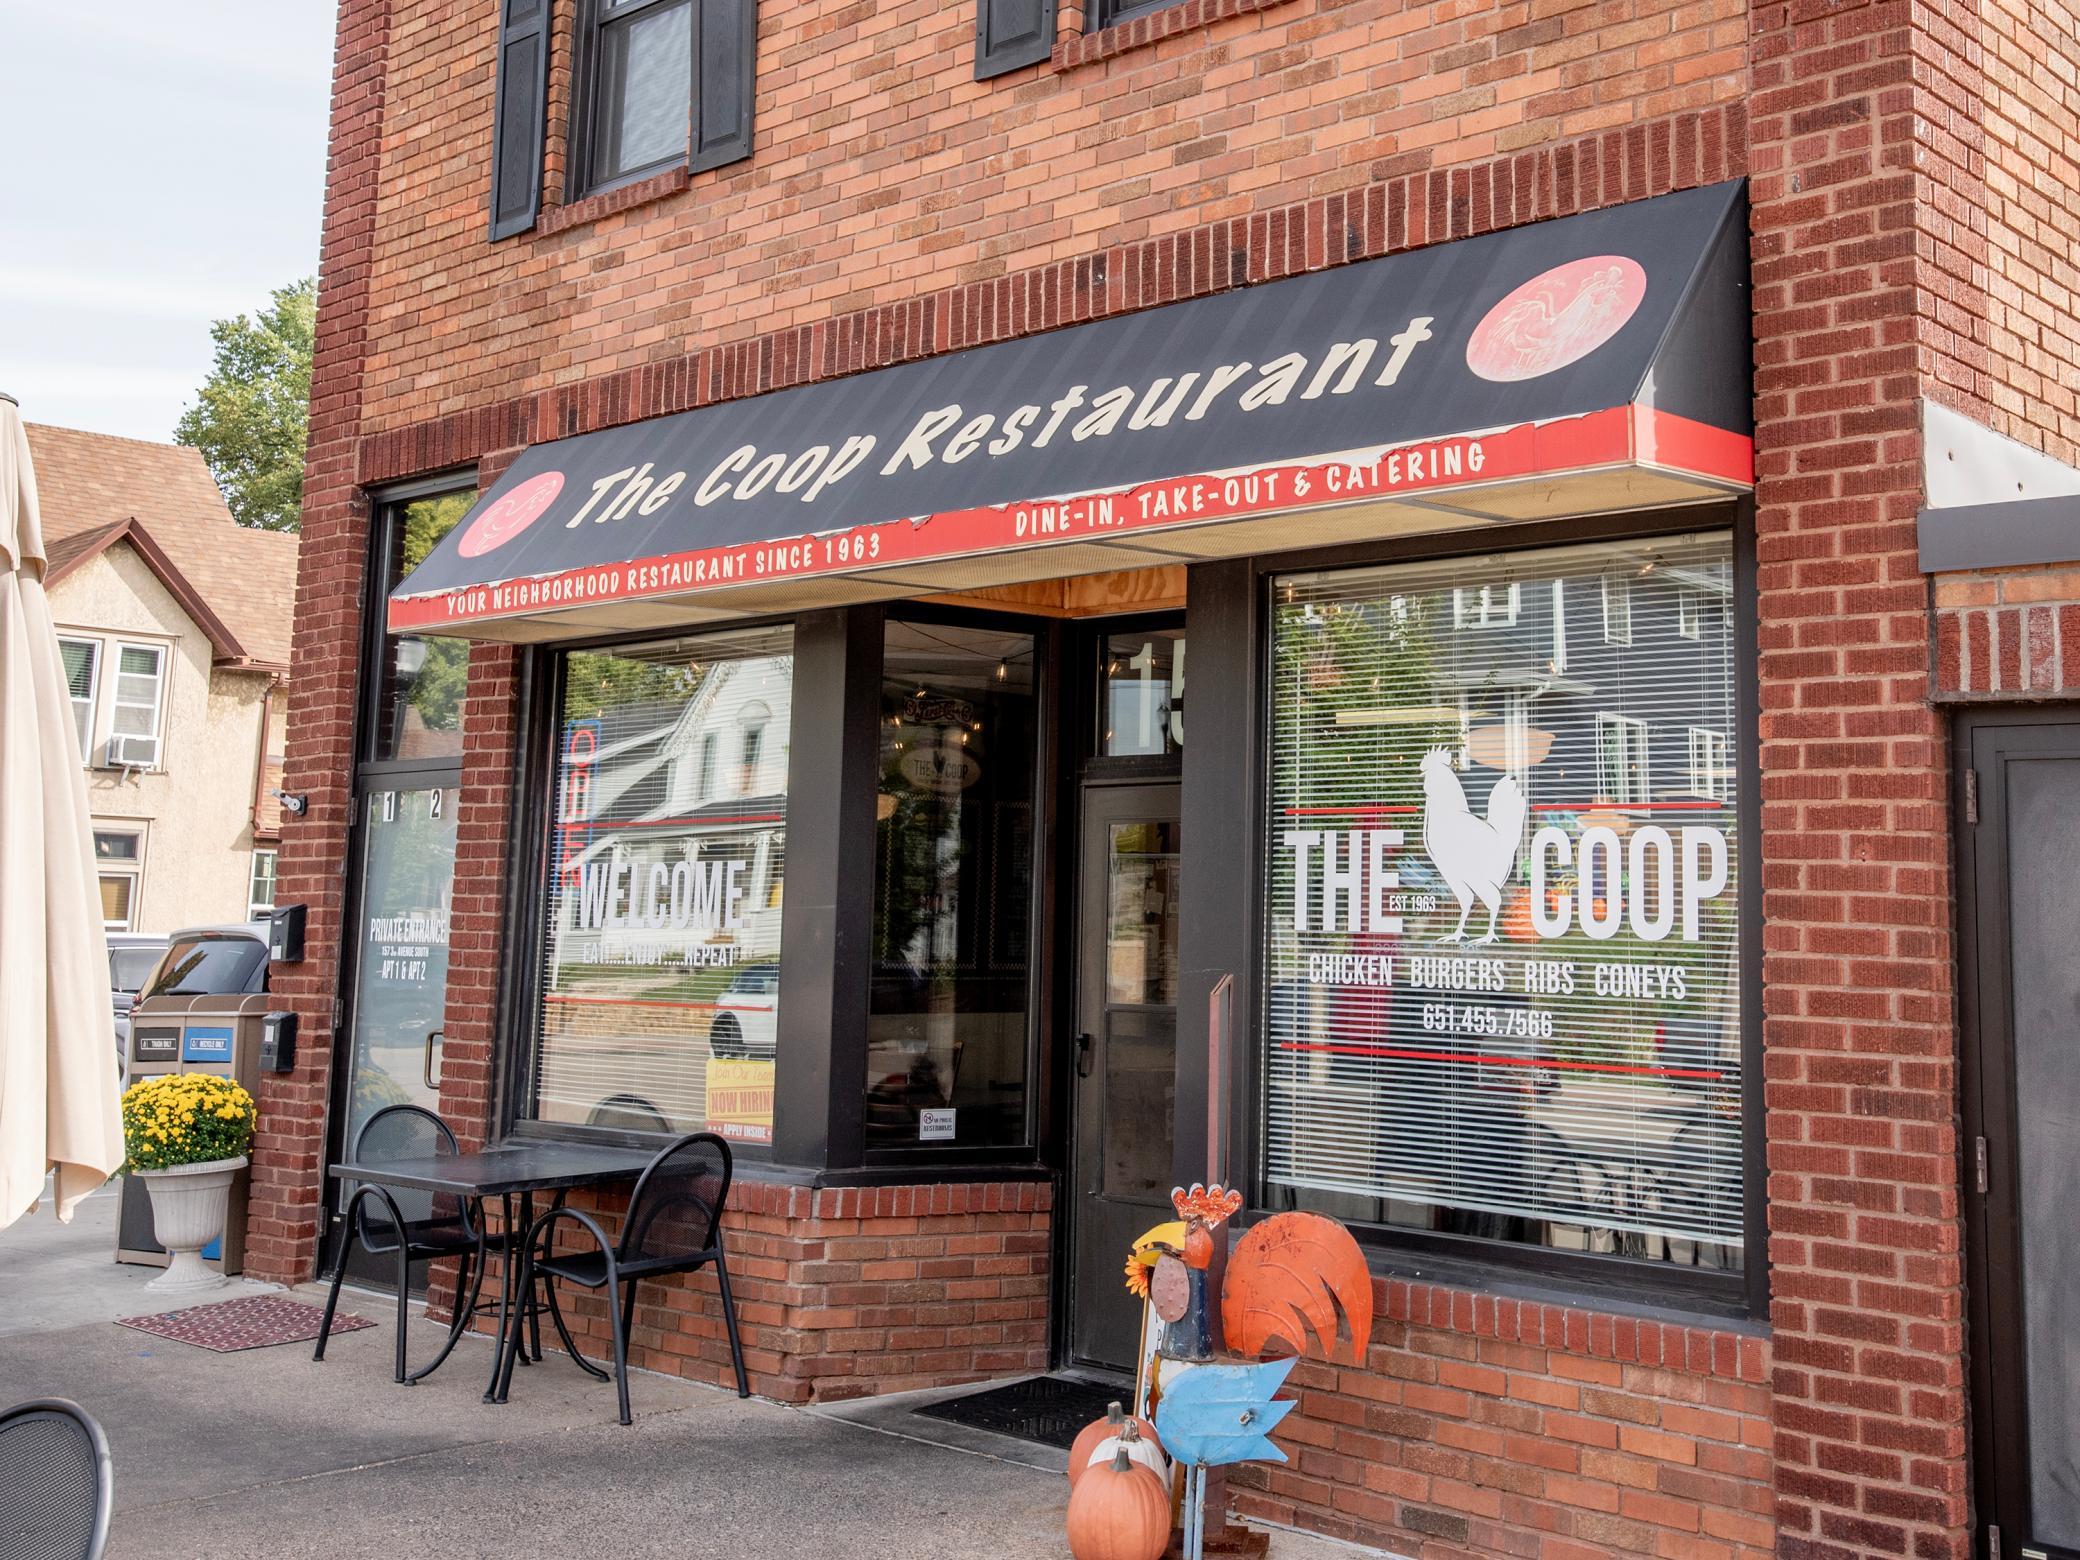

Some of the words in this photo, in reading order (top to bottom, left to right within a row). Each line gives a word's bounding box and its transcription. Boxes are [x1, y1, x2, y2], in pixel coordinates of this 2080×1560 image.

[565, 462, 687, 529] The
[694, 435, 877, 507] Coop
[880, 316, 1435, 476] Restaurant
[1015, 498, 1124, 537] DINE-IN,
[1138, 472, 1279, 519] TAKE-OUT
[1294, 470, 1311, 497] &
[1327, 442, 1486, 493] CATERING
[447, 591, 486, 616] YOUR
[493, 571, 619, 610] NEIGHBORHOOD
[627, 553, 747, 591] RESTAURANT
[756, 543, 813, 574] SINCE
[825, 532, 880, 564] 1963
[913, 759, 931, 777] THE
[387, 793, 393, 819] 1
[431, 790, 440, 818] 2
[579, 860, 746, 930] WELCOME
[1283, 829, 1404, 933] THE
[1530, 825, 1728, 942] COOP
[1389, 896, 1408, 913] EST
[1410, 895, 1436, 913] 1963
[370, 918, 403, 943] PRIVATE
[403, 919, 447, 944] ENTRANCE
[382, 960, 394, 980] APT
[395, 960, 400, 980] 1
[408, 961, 421, 980] APT
[421, 961, 426, 981] 2
[1308, 953, 1392, 987] CHICKEN
[1410, 958, 1505, 992] BURGERS
[1524, 960, 1575, 995] RIBS
[1594, 962, 1686, 1000] CONEYS
[1422, 1002, 1553, 1038] 651.455.7566
[711, 1092, 737, 1113] NOW
[740, 1091, 774, 1112] HIRIN
[723, 1124, 743, 1136] APPLY
